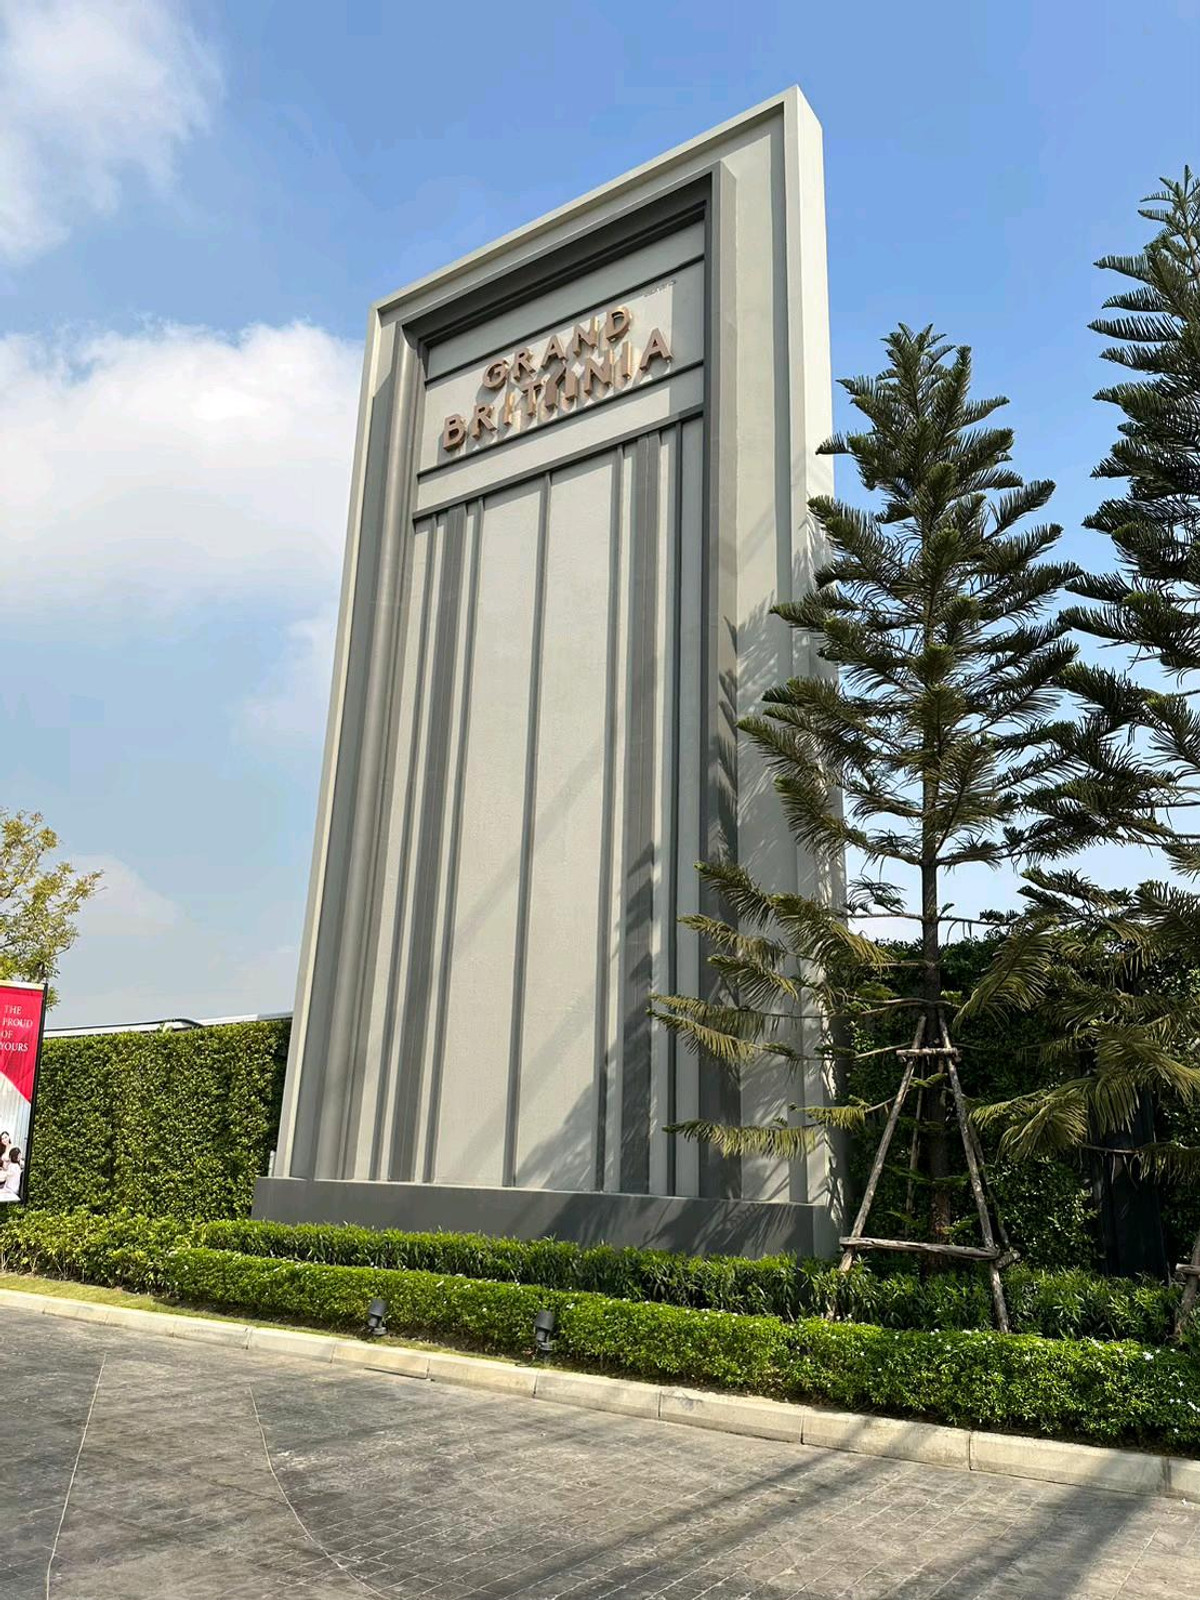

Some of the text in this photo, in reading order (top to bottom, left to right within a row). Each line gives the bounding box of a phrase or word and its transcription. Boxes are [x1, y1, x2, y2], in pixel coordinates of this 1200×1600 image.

[482, 306, 633, 389] GRAND
[443, 328, 673, 451] BRITANIA
[4, 1005, 22, 1014] THE
[2, 1017, 33, 1027] PROUD
[0, 1030, 13, 1039] OF
